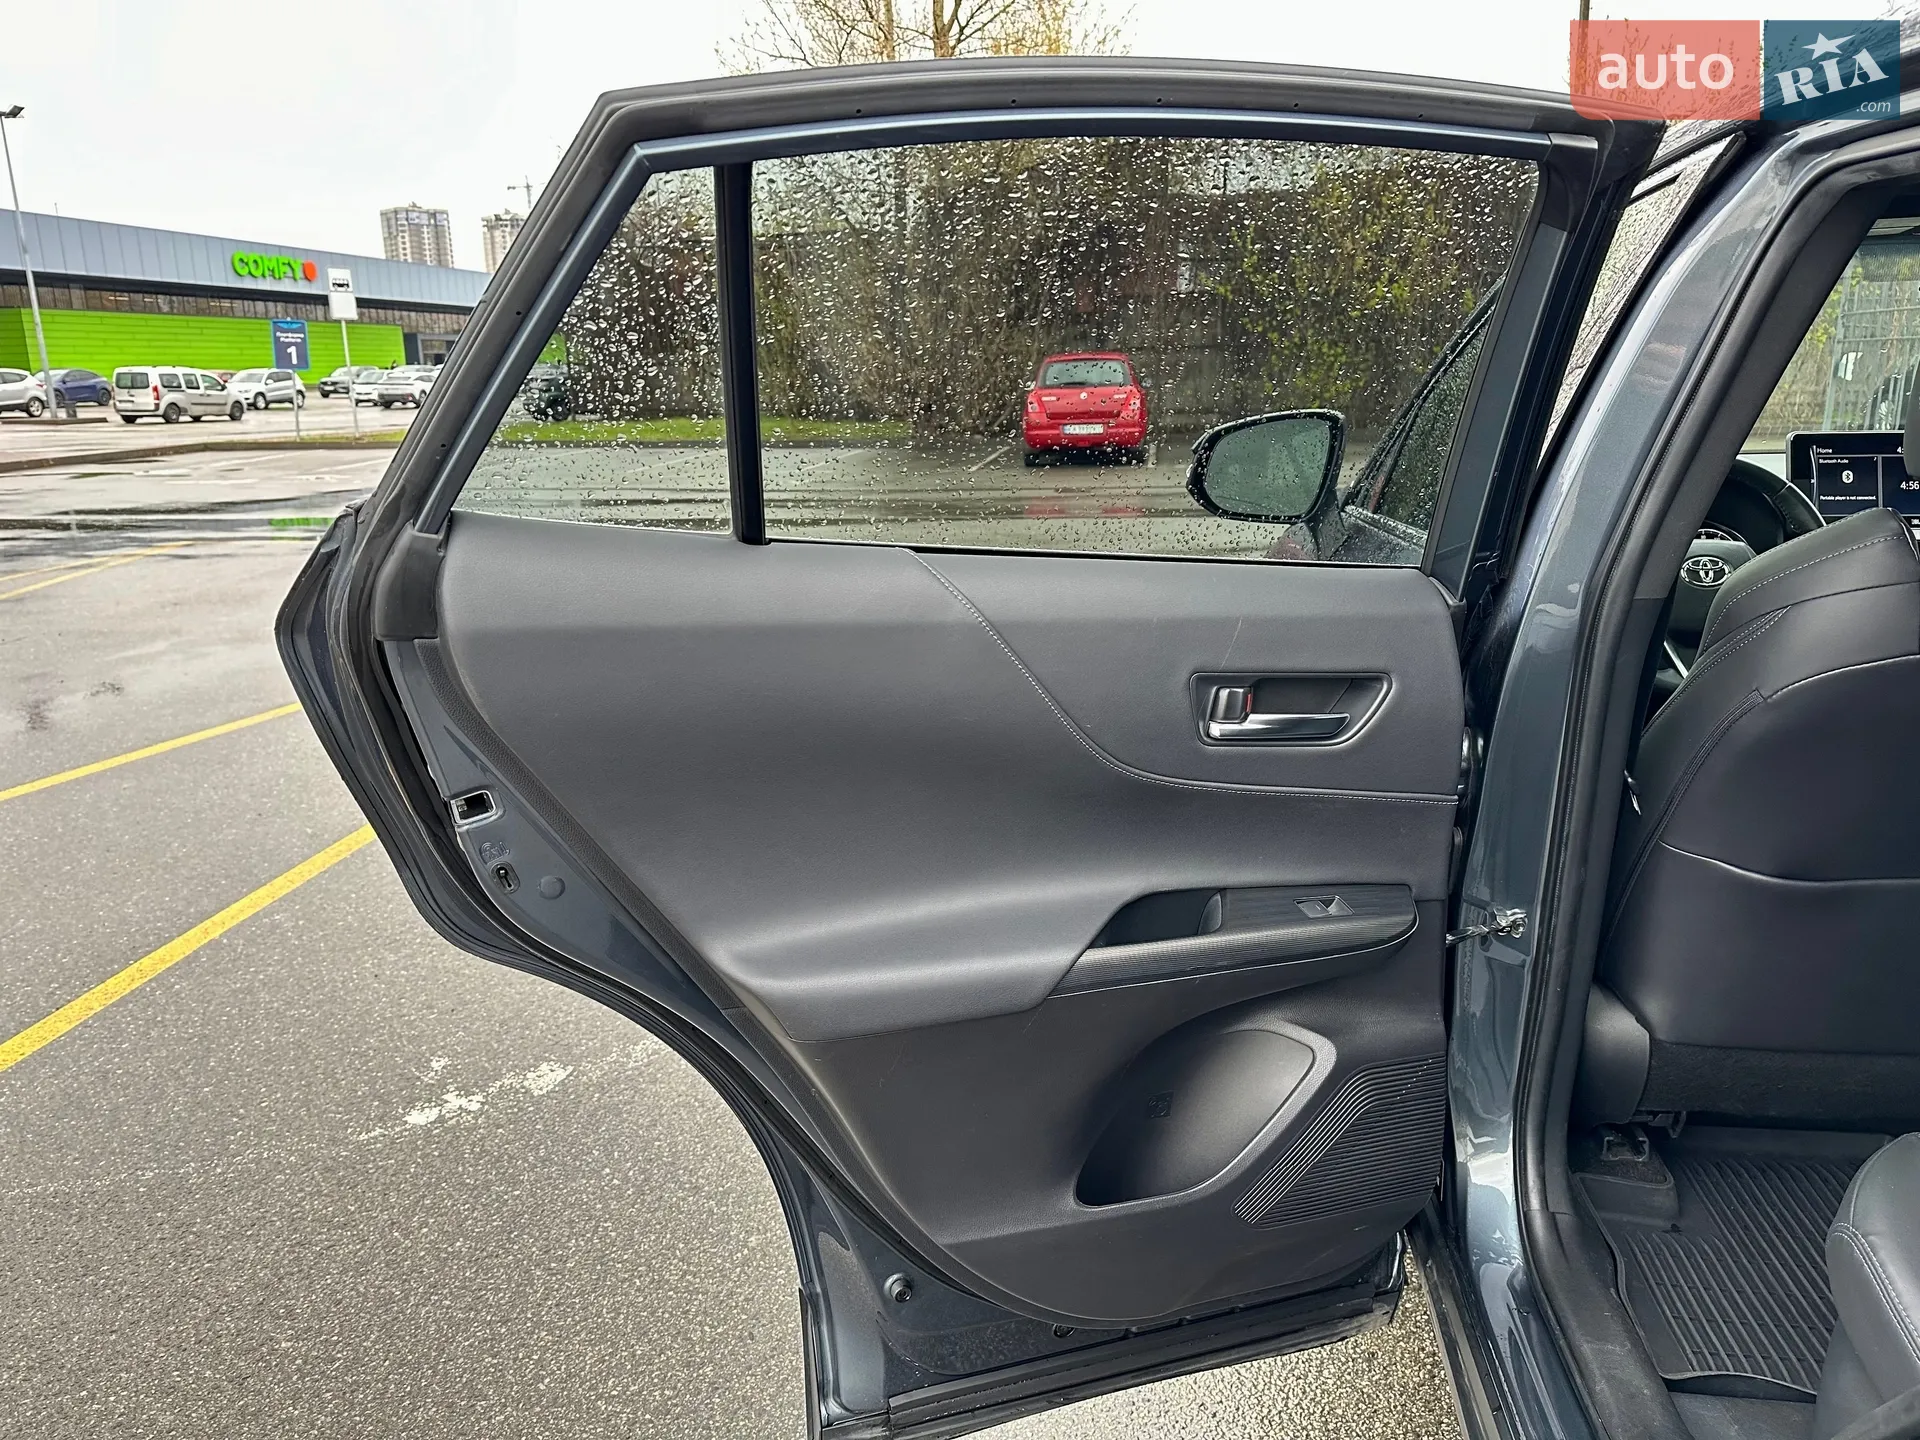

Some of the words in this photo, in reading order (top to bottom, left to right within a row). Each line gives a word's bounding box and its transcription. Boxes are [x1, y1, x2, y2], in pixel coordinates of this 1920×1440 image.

[231, 250, 302, 281] COMFY
[286, 345, 298, 365] 1
[1900, 481, 1920, 490] 4:56
